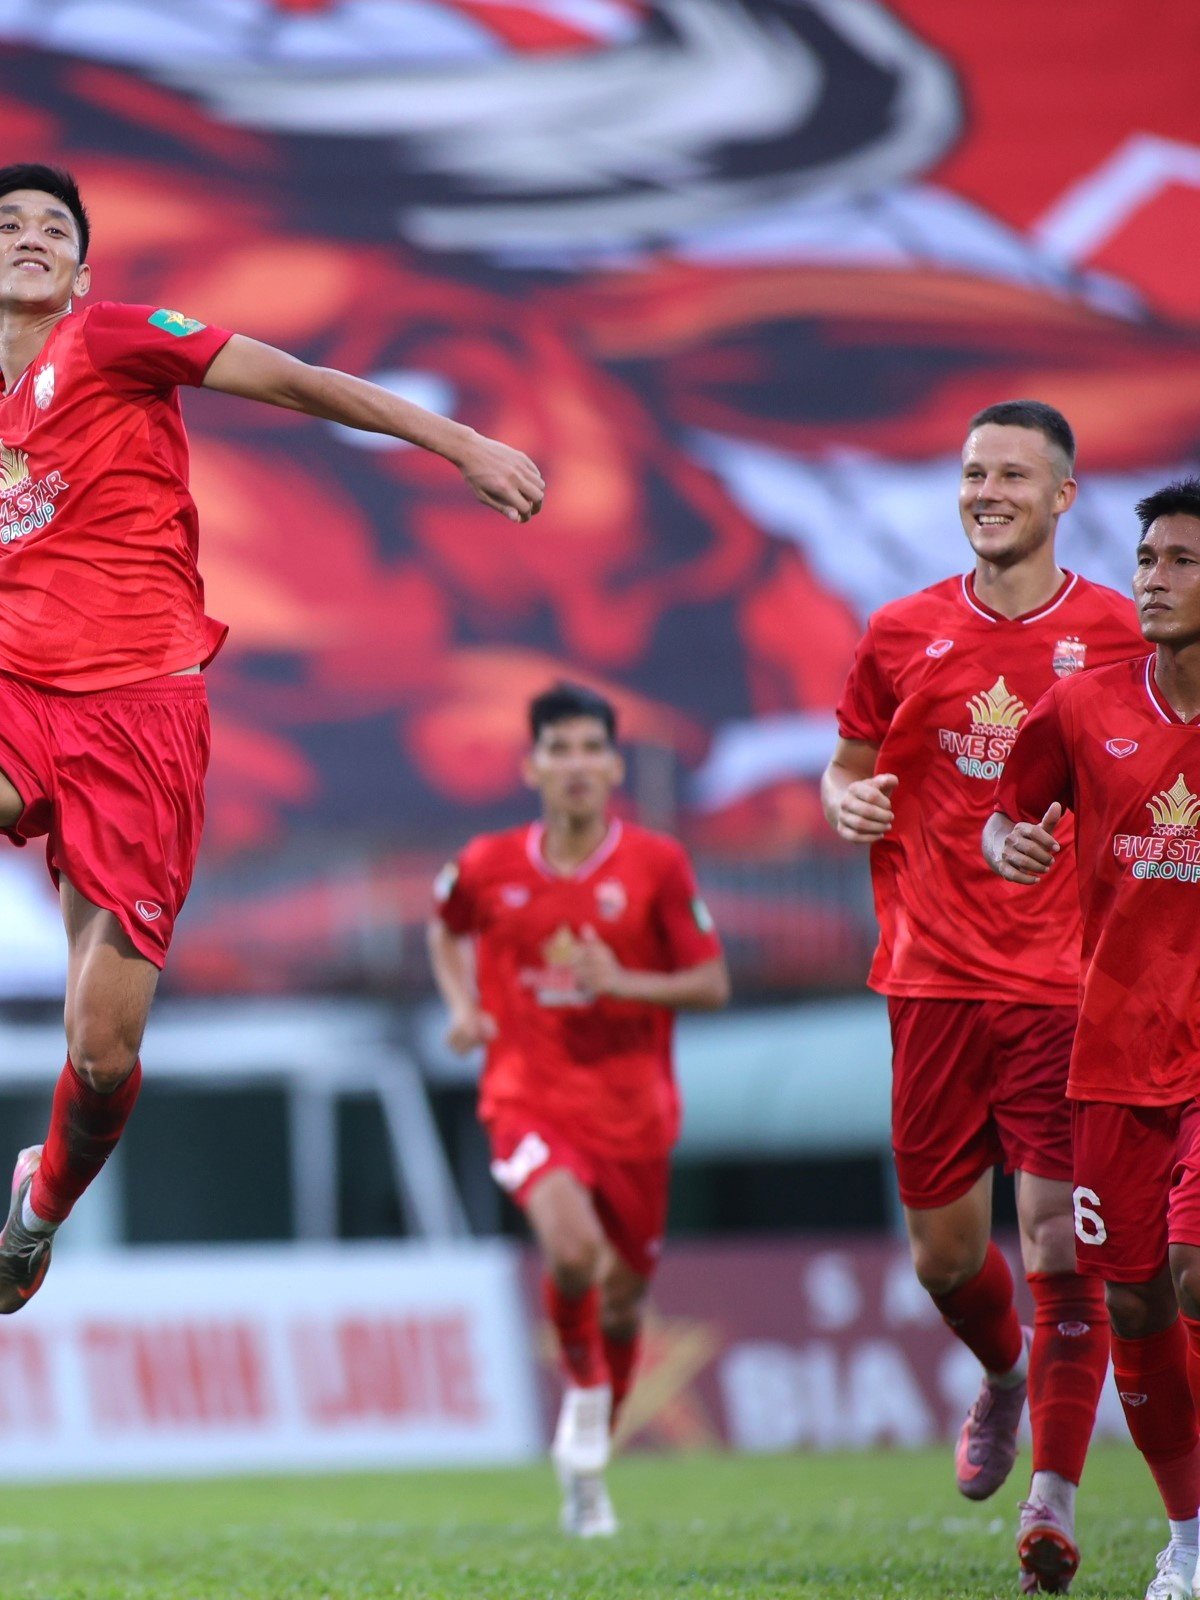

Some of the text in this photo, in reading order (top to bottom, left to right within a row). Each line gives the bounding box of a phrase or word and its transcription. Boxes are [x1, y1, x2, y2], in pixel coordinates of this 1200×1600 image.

[17, 470, 70, 514] STAR
[0, 502, 55, 545] GROUP
[938, 728, 1017, 762] FIVE ST
[955, 756, 1005, 780] GRO
[1113, 834, 1200, 864] FIVE ST
[1072, 1185, 1108, 1246] 6
